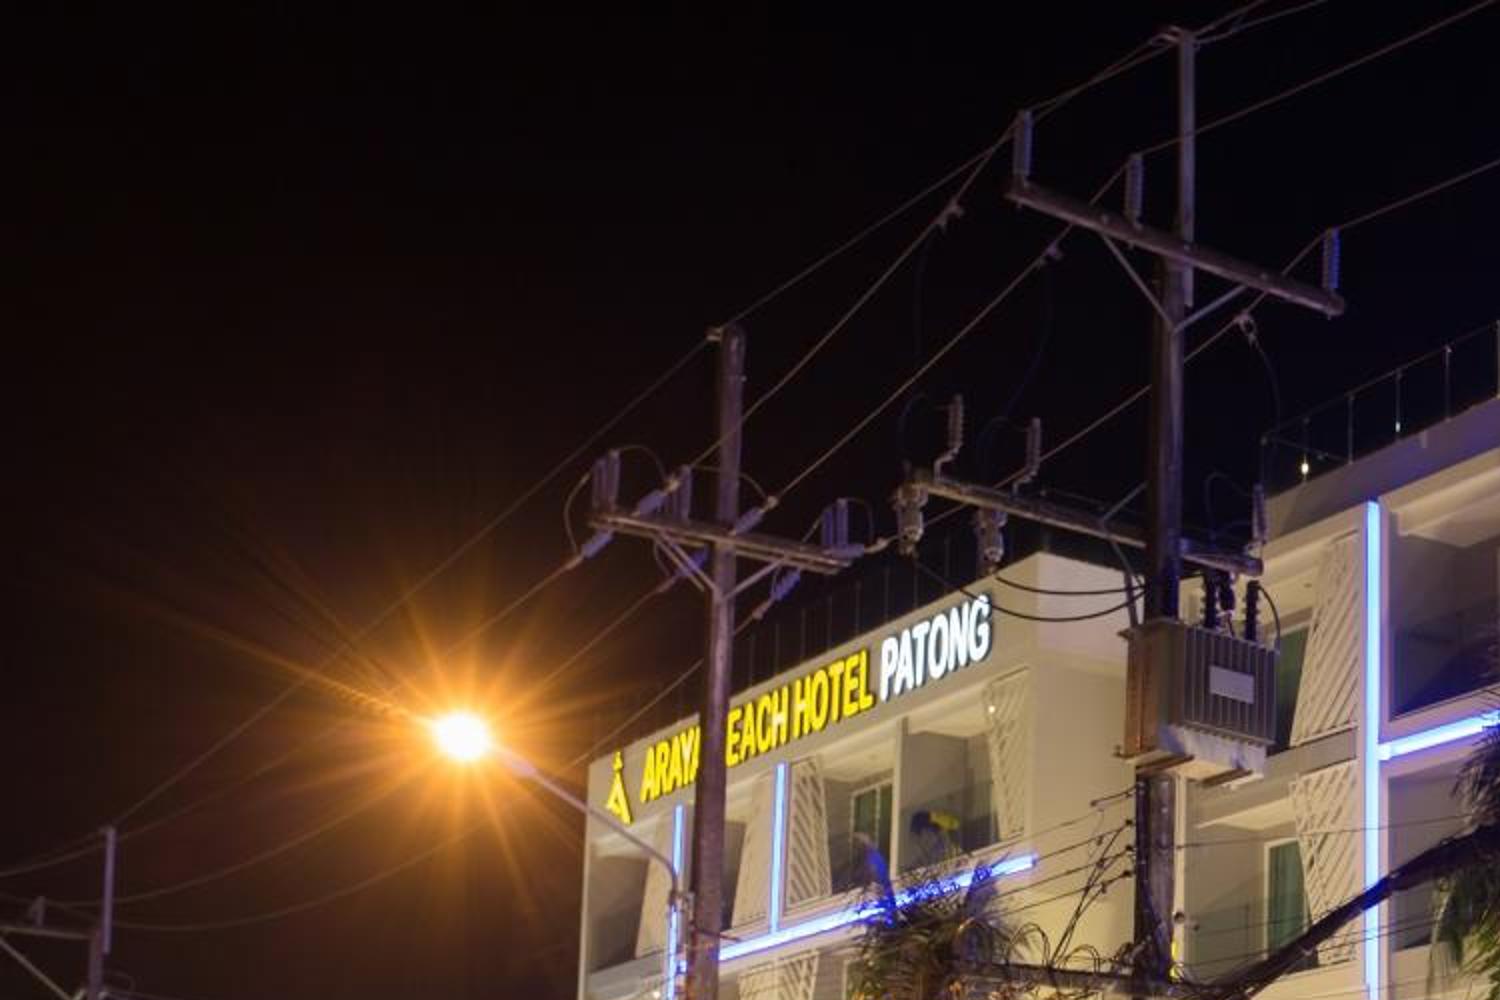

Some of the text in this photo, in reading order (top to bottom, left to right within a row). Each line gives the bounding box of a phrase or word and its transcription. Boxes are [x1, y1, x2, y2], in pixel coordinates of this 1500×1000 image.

[726, 686, 788, 768] EACH
[793, 650, 873, 738] HOTEL
[880, 595, 990, 701] PATONG
